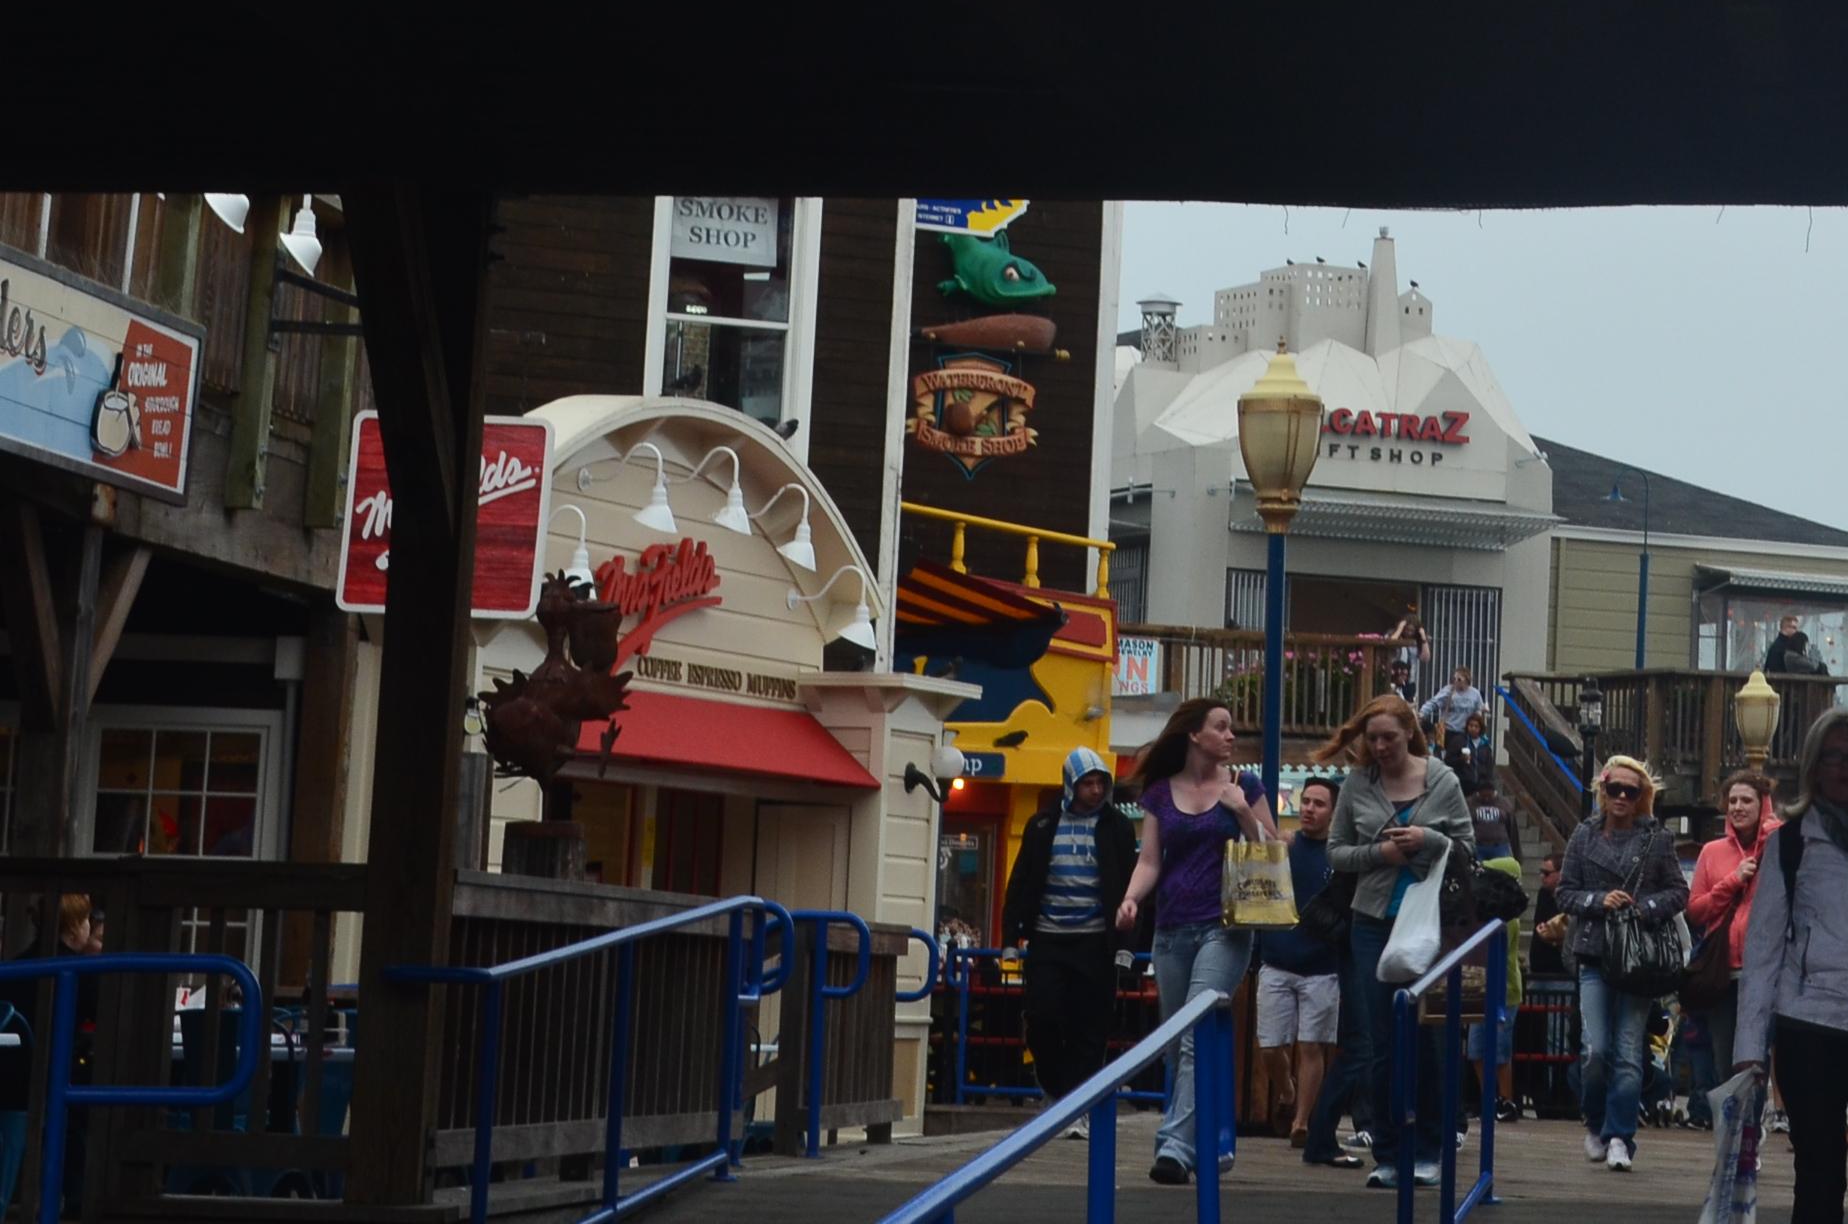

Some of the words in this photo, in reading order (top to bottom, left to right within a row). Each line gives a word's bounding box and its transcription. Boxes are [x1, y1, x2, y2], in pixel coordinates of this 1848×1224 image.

[679, 198, 769, 225] SMOKE
[688, 225, 757, 249] SHOP
[127, 362, 168, 387] ORIGINAL
[921, 371, 1028, 400] WATERFRONT
[1320, 408, 1470, 444] CATRAZ
[1328, 443, 1360, 460] FT
[1370, 447, 1444, 466] SHOP
[636, 655, 683, 683] COFFEE
[686, 662, 743, 692] ESPRESSO
[746, 672, 797, 700] MUFFINS
